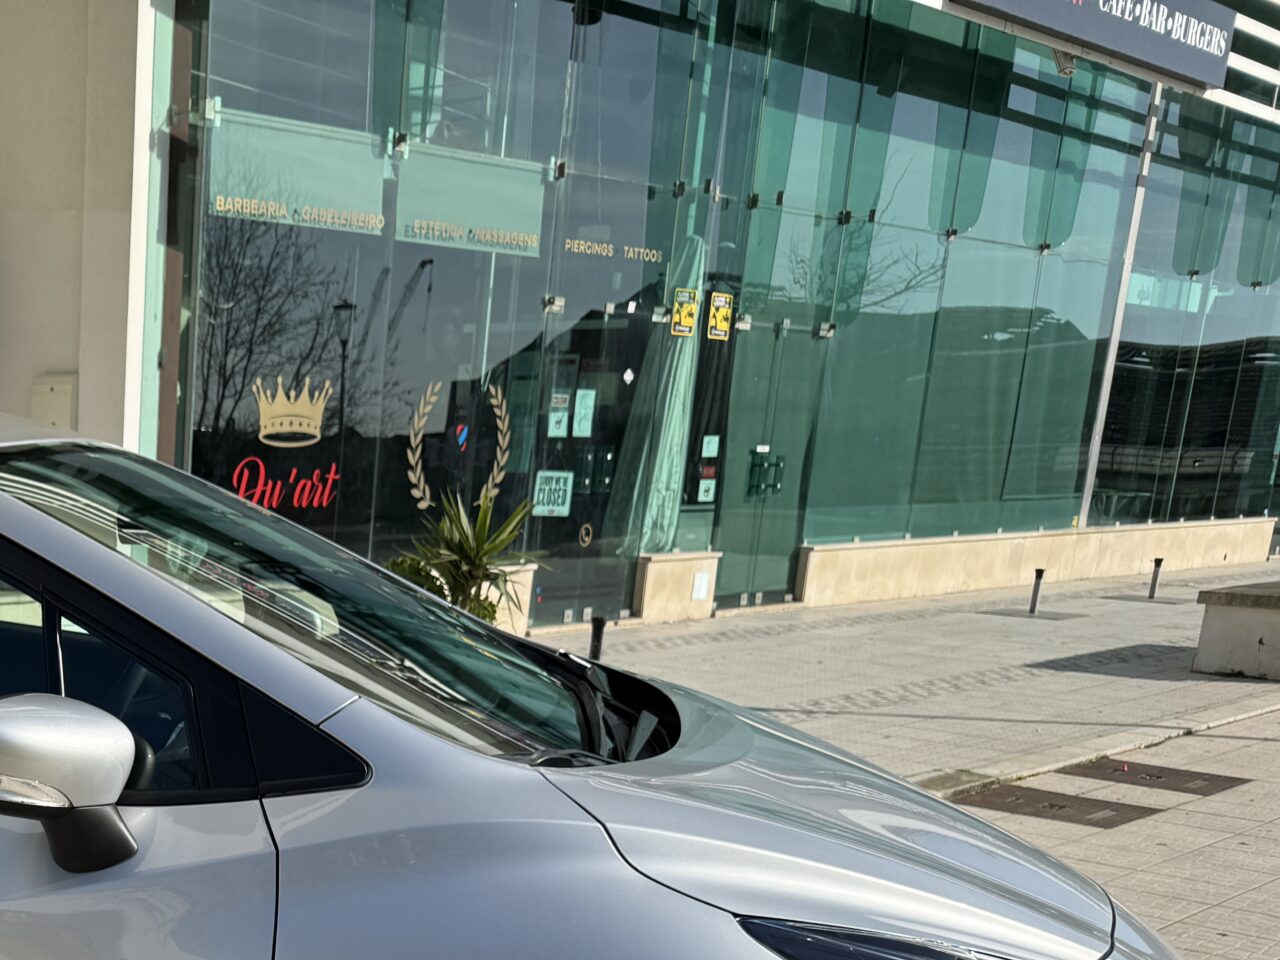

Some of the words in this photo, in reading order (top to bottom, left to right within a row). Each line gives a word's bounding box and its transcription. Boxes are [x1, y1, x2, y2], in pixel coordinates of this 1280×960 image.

[1171, 11, 1228, 57] BURGERS
[215, 195, 289, 218] BARBEARIA
[301, 205, 385, 229] CABELEIREIRO
[474, 229, 538, 248] MASSAGENS
[565, 239, 615, 257] PIERCINGS
[623, 245, 663, 263] TATTOOS
[536, 487, 568, 507] CLOSED
